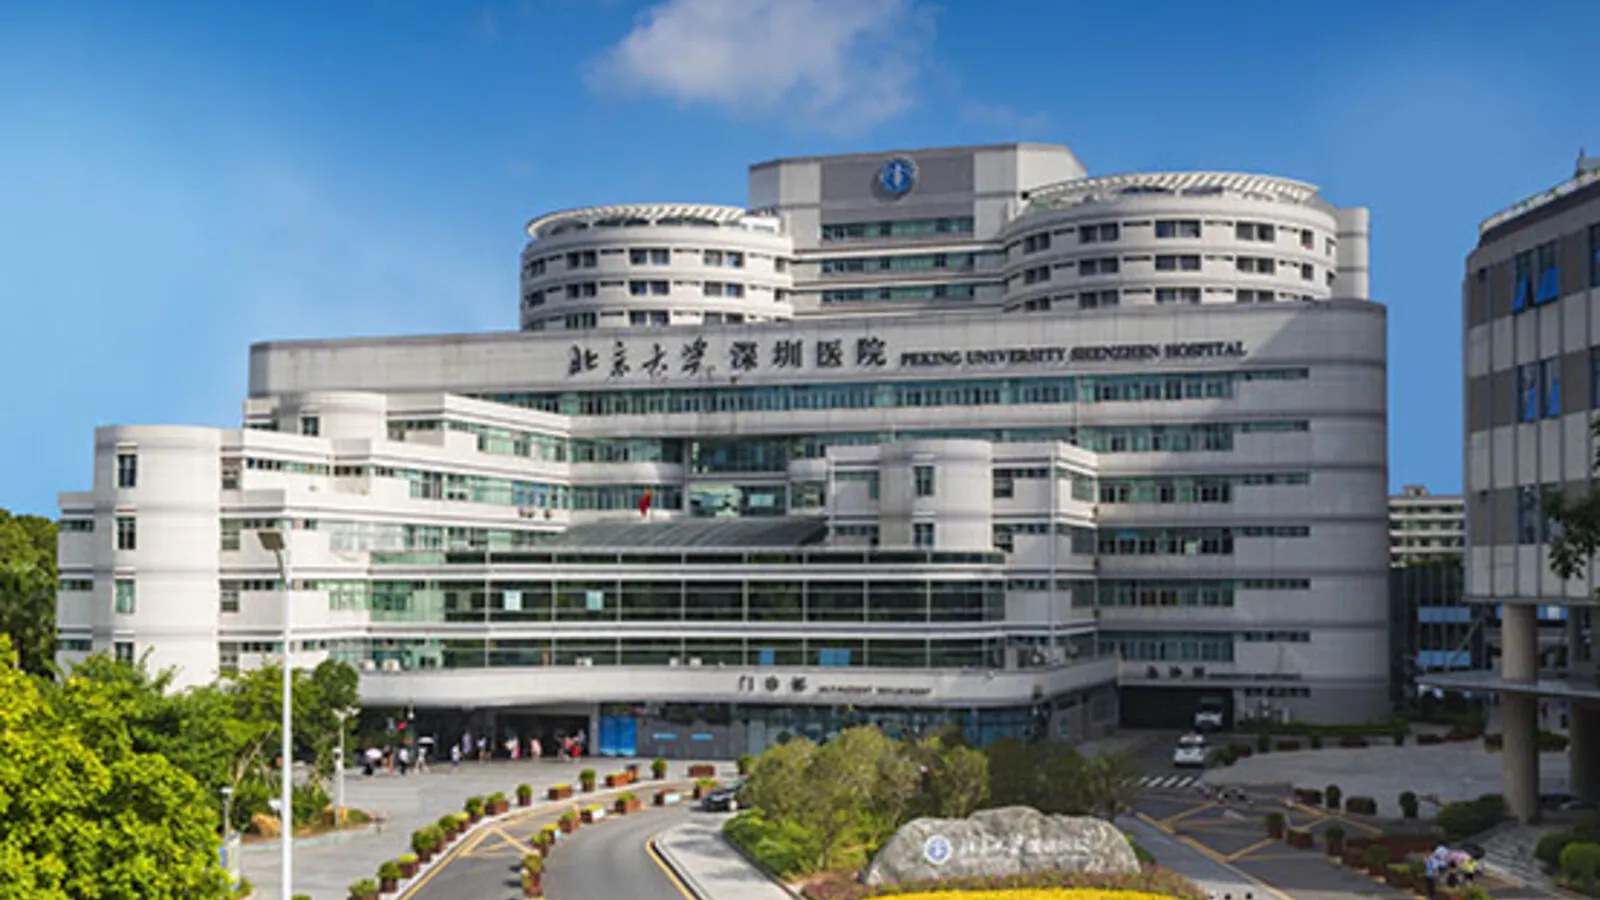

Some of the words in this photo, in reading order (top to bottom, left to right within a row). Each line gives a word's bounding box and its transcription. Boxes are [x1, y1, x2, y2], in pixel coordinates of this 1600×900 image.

[900, 351, 961, 368] PEKING
[967, 347, 1066, 366] UNIVERSITY
[1165, 340, 1246, 361] HOSPITAL
